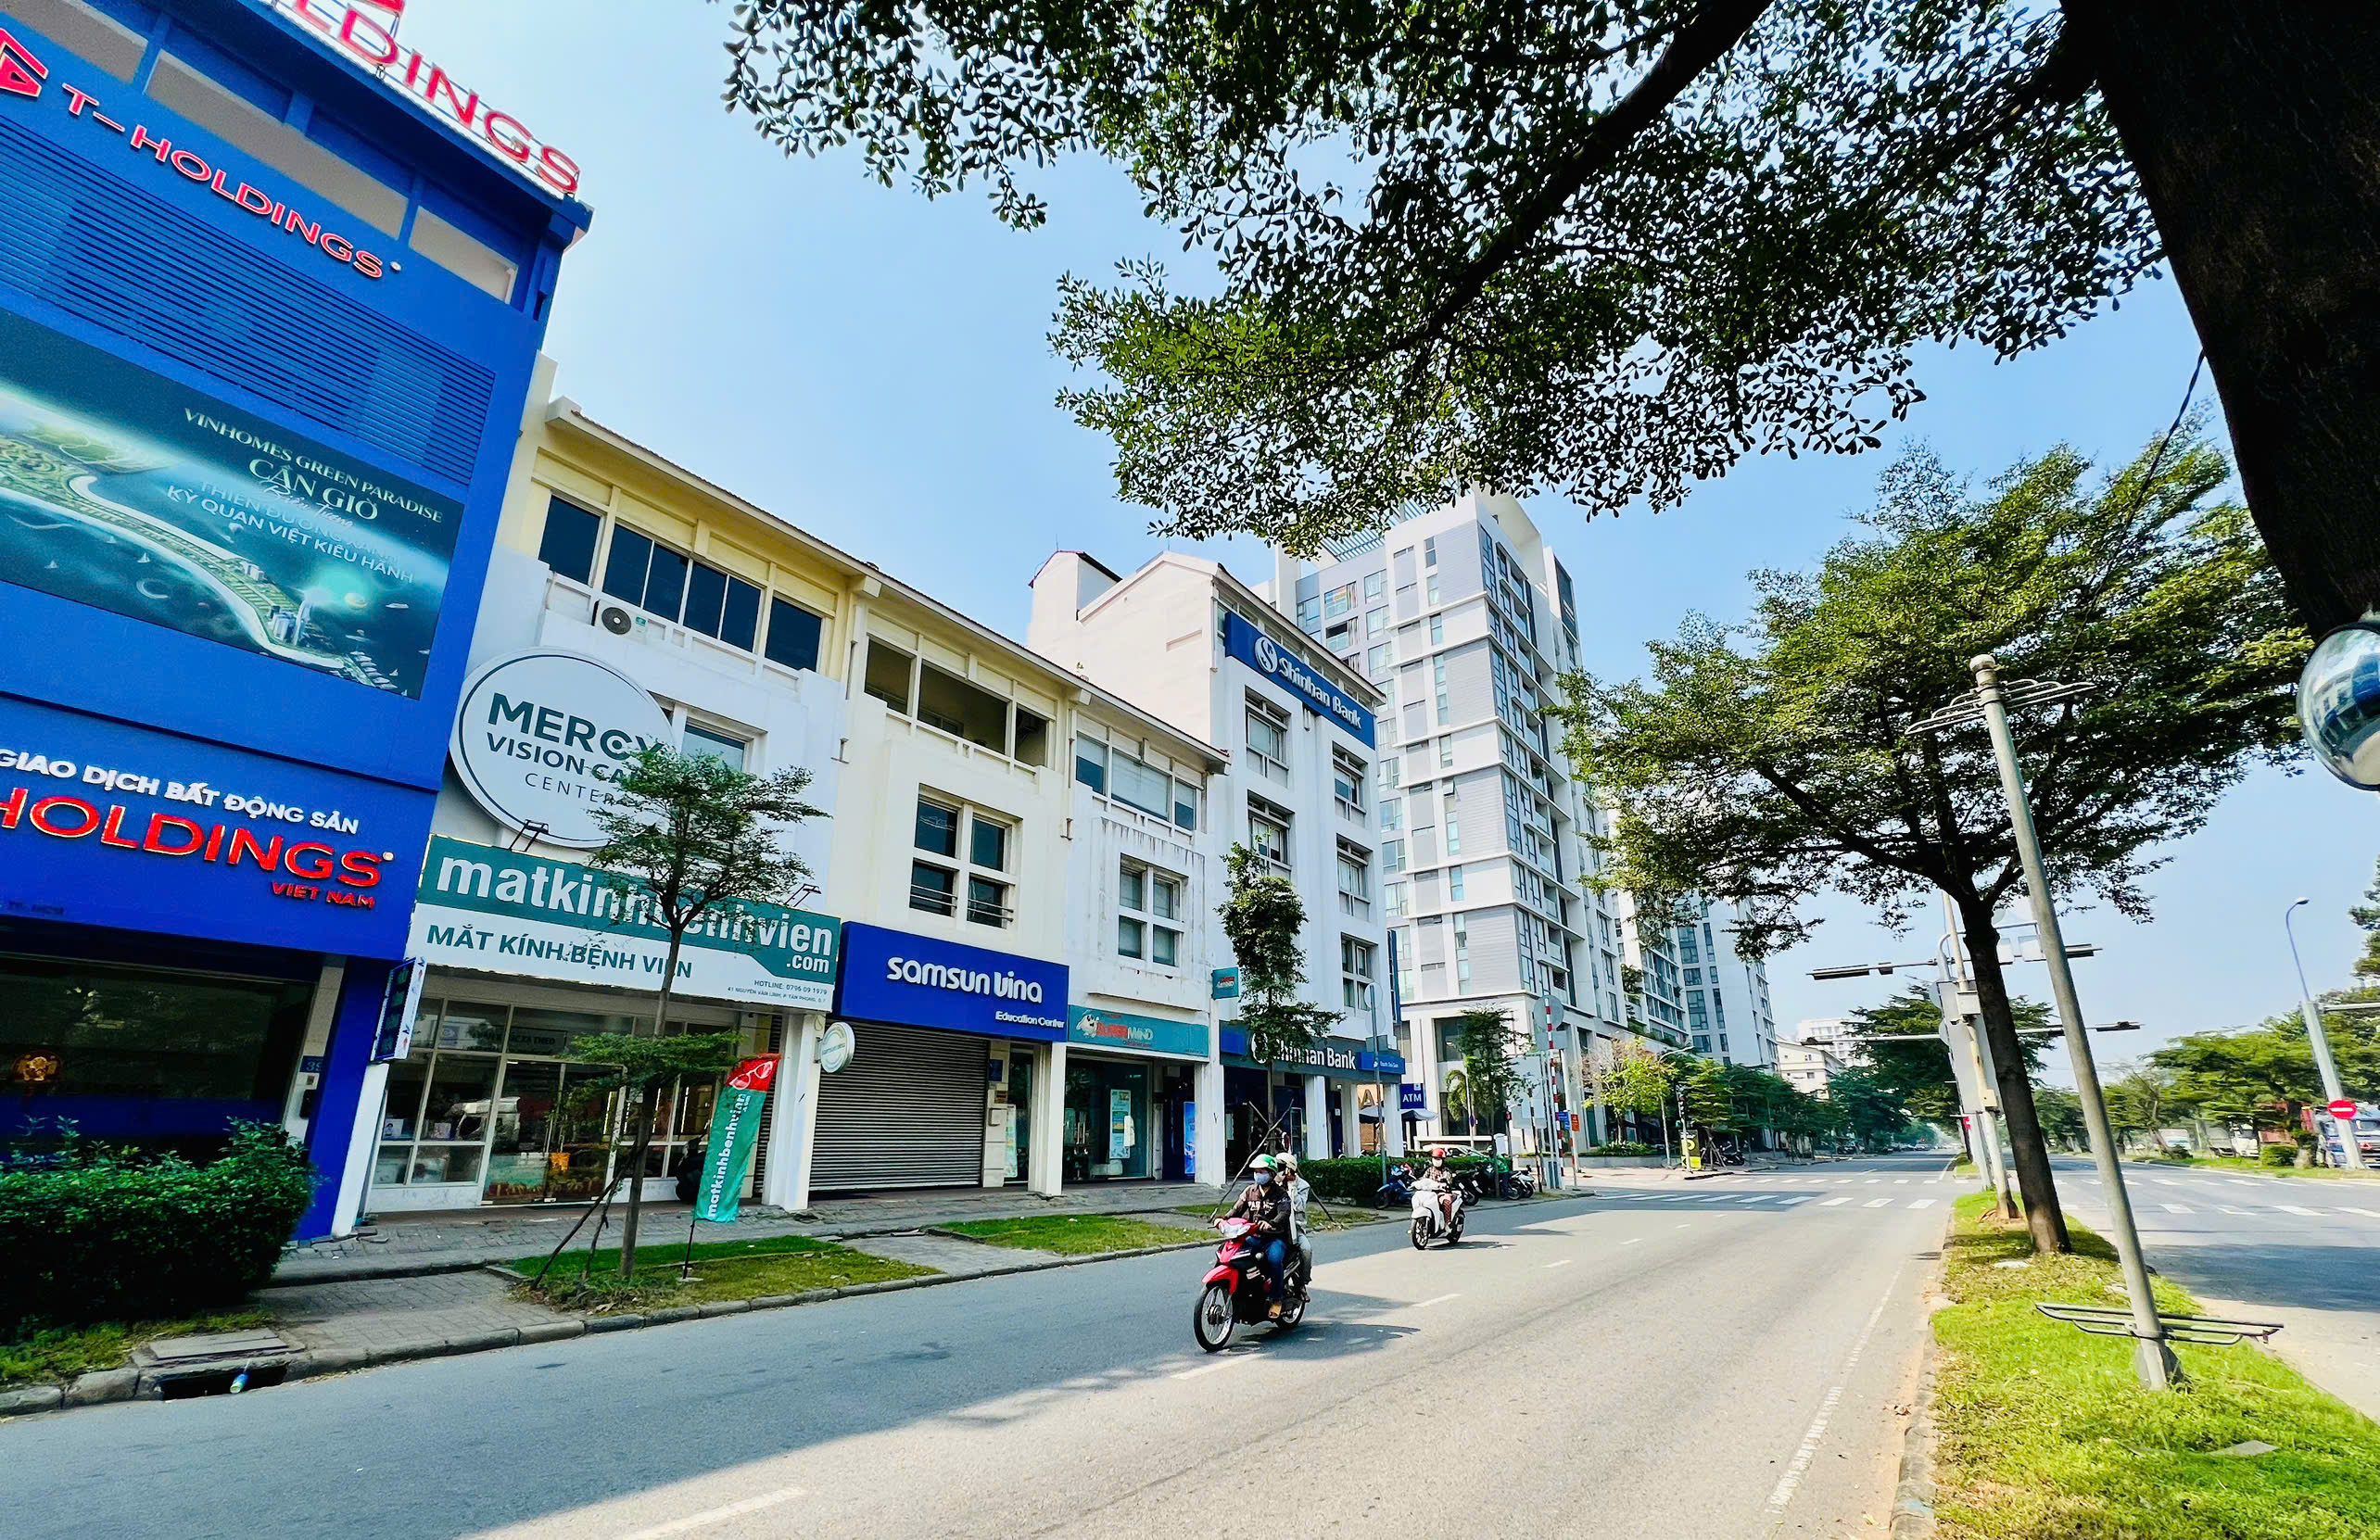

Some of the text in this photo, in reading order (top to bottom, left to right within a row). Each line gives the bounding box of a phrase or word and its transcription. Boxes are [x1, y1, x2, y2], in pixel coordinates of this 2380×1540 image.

[184, 407, 443, 524] VINHOMES GREEN PARADISE
[201, 498, 265, 530] QUAN
[269, 521, 312, 546] VIỆT
[314, 538, 358, 563] KIÊU
[361, 555, 414, 584] HÃNH
[1279, 656, 1362, 730] Shinhan Bank
[487, 732, 586, 776] VISION
[0, 748, 360, 835] GIAO DỊCH BẤT ĐỘNG SẢN
[326, 890, 376, 909] NAM
[437, 856, 832, 956] matkinhenhvien
[426, 923, 693, 978] MẮT KÍNH BỆNH VIN
[786, 954, 830, 974] .com
[994, 1010, 1065, 1029] Education Center
[1272, 1037, 1357, 1070] hinan Bank
[1401, 1092, 1423, 1103] ATM
